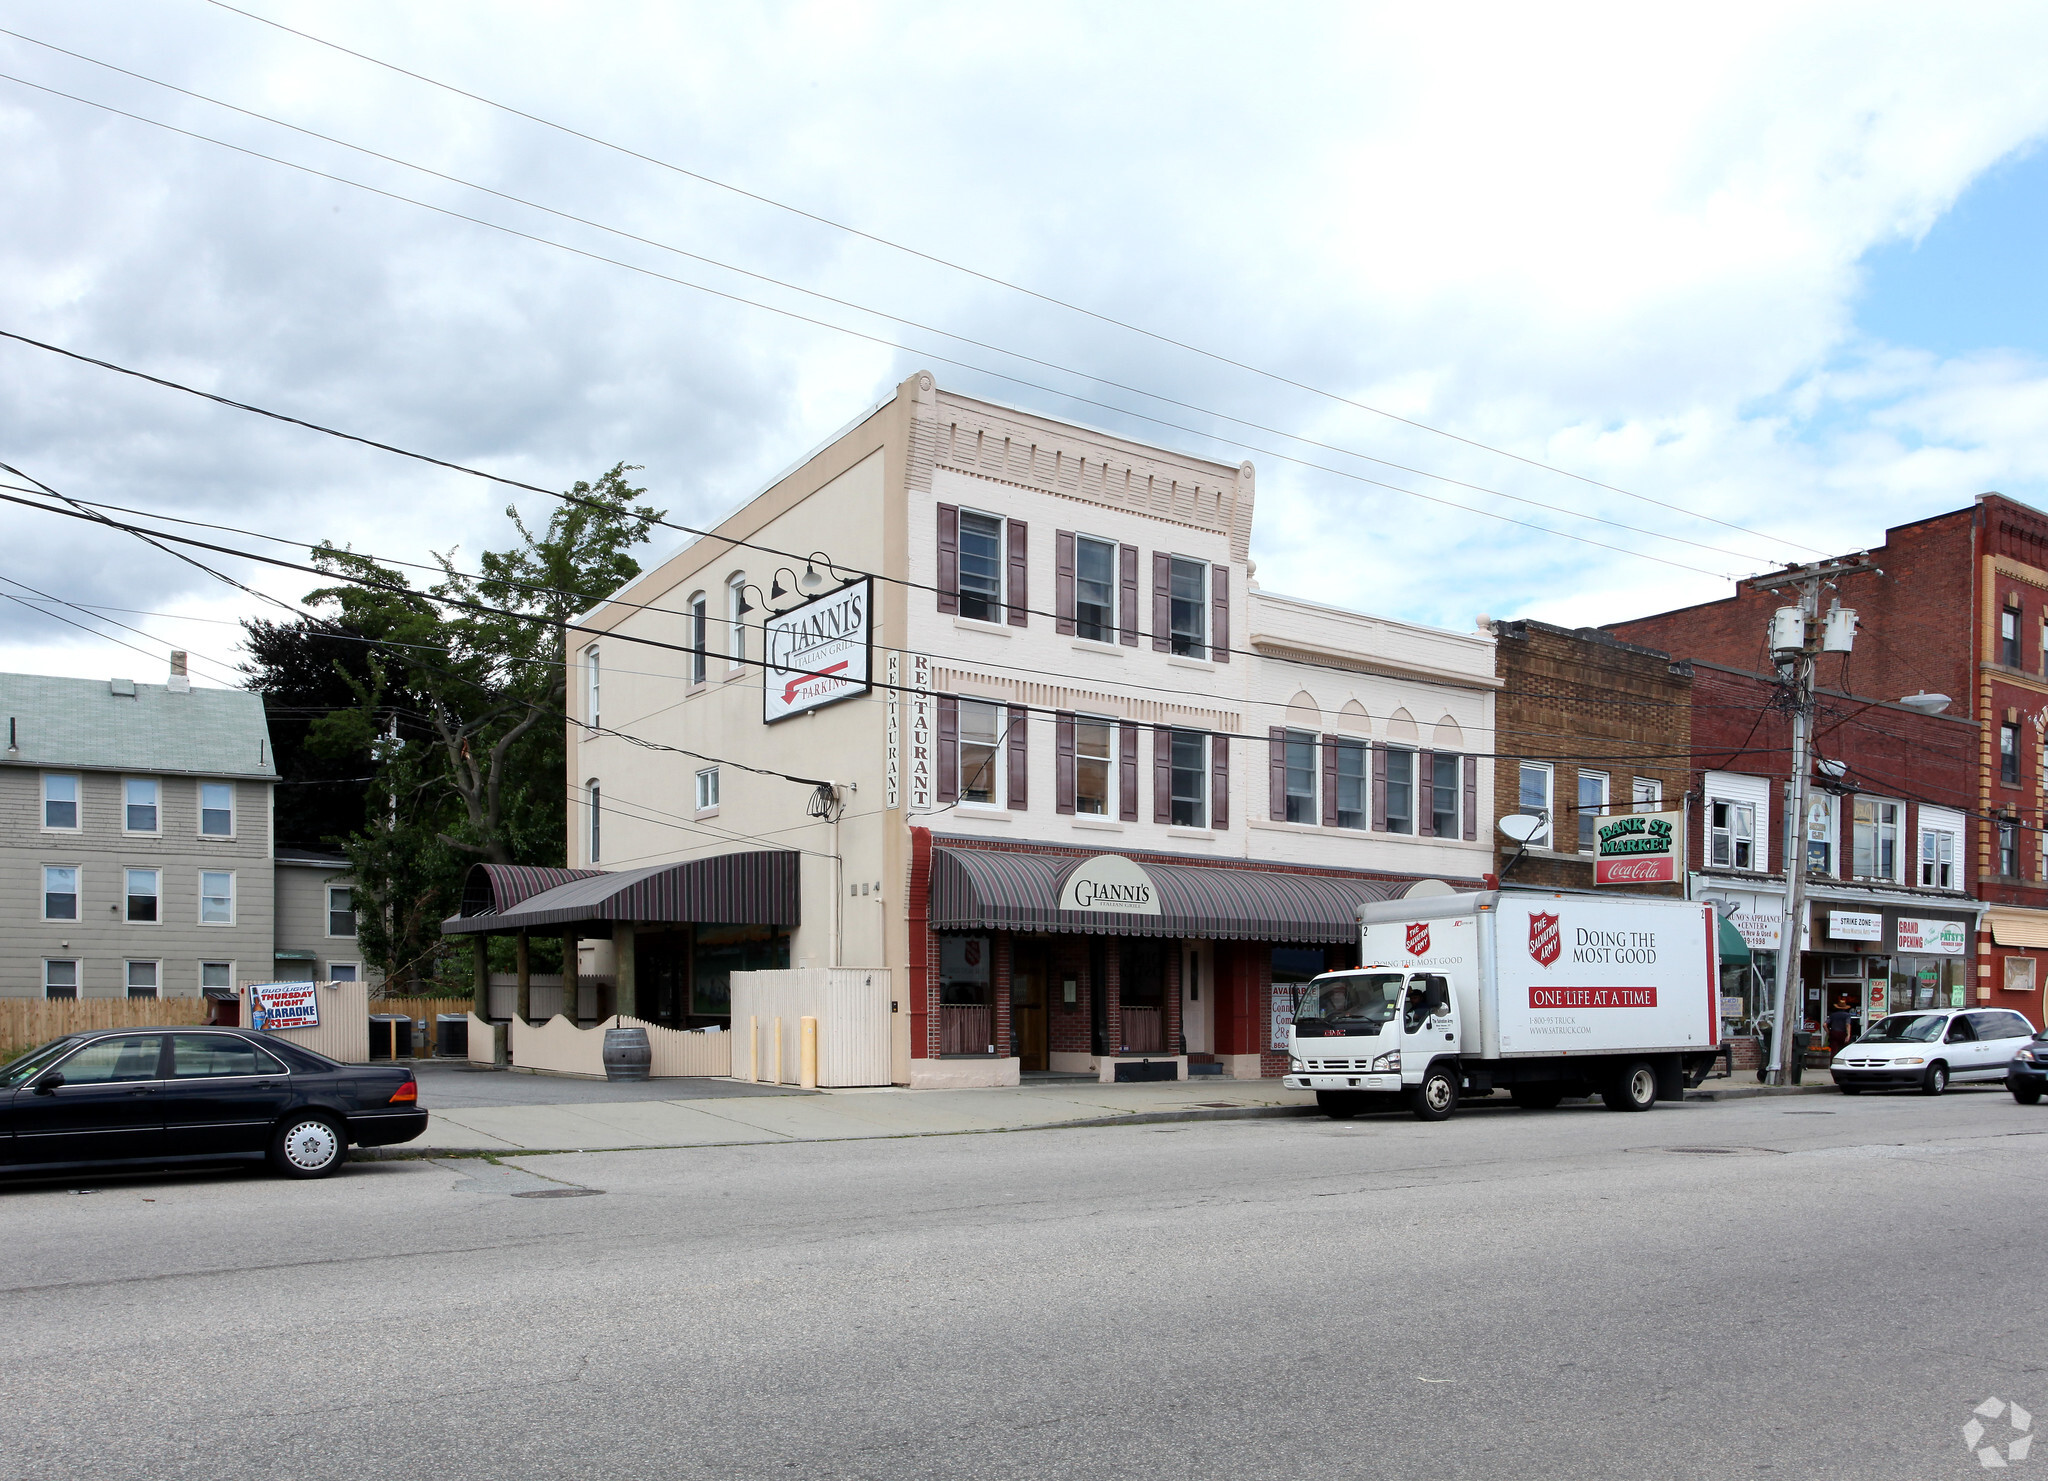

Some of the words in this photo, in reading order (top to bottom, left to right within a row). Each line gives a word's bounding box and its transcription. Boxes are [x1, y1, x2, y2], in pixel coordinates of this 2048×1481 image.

[772, 592, 862, 675] GIANNI'S
[794, 650, 827, 668] ITALIAN
[829, 639, 855, 655] GRILL
[802, 673, 848, 700] PARKING
[888, 657, 897, 804] RESTAURANT
[914, 656, 928, 804] RESTAURANT
[1598, 817, 1646, 841] BANK
[1648, 819, 1672, 838] ST.
[1600, 837, 1672, 856] MARKET
[1608, 860, 1660, 879] Coca-Cola
[1075, 880, 1150, 907] GIANNI'S
[1533, 917, 1547, 934] THE
[1751, 915, 1781, 923] APPLIANCE
[1840, 917, 1857, 925] STRIKE
[1363, 927, 1368, 936] 2
[1409, 925, 1420, 937] THE
[1899, 921, 1918, 934] GRAND
[1406, 926, 1429, 950] SALVATION
[1530, 919, 1558, 954] SALVATION
[1576, 927, 1626, 947] DOING
[1629, 932, 1656, 948] THE
[1898, 935, 1923, 948] OPENING
[1940, 932, 1964, 942] PATSY'S
[1414, 937, 1428, 953] ARMY
[1540, 937, 1558, 960] ARMY
[1401, 959, 1416, 967] THE
[1416, 958, 1437, 966] MOST
[1439, 956, 1463, 965] GOOD
[1573, 947, 1612, 963] MOST
[1615, 949, 1656, 964] GOOD
[261, 991, 314, 1001] THURSDAY
[272, 999, 304, 1007] NIGHT
[1534, 990, 1562, 1005] ONE
[1566, 990, 1590, 1005] LIFE
[1593, 990, 1609, 1005] AT
[1610, 991, 1619, 1005] A
[1621, 990, 1651, 1005] TIME
[267, 1006, 315, 1018] KARAOKE
[1554, 1016, 1576, 1025] TRUCK
[1529, 1026, 1592, 1035] WWW.SATRUCK.COM
